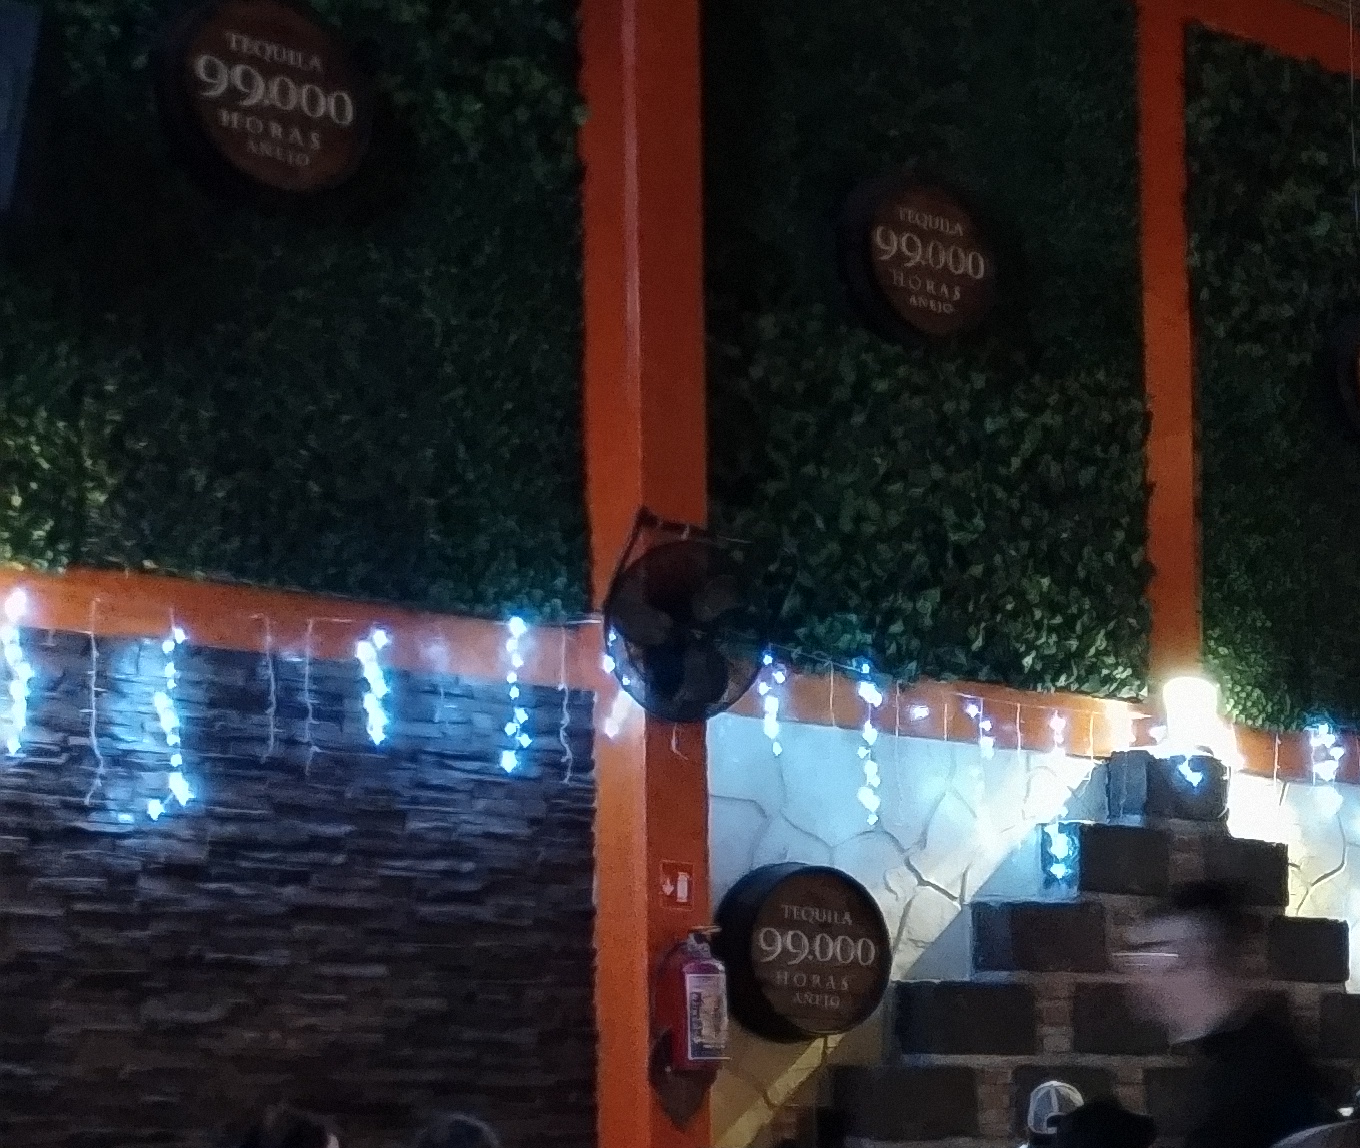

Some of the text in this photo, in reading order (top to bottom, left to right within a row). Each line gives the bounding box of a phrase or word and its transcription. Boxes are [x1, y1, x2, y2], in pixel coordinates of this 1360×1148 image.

[225, 31, 323, 72] TEQUILA
[218, 107, 321, 151] HORAS
[898, 205, 963, 237] TEQUILA
[889, 267, 961, 301] HORAS
[781, 904, 852, 926] TEQUILA
[759, 927, 876, 966] 99.000
[776, 971, 849, 991] HORAS
